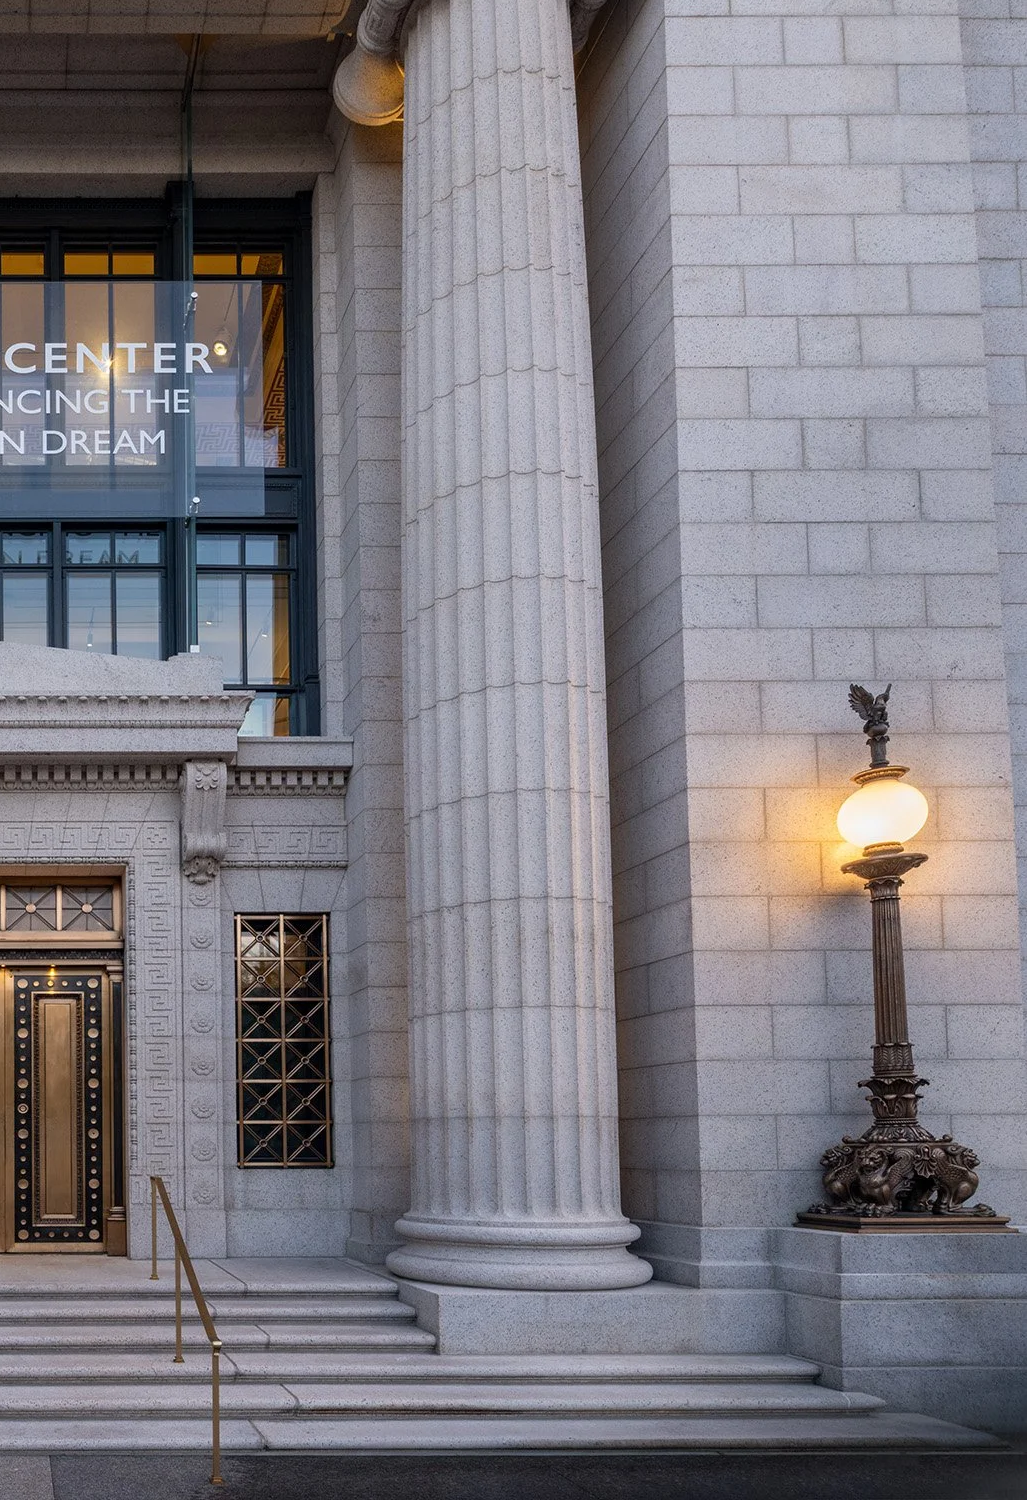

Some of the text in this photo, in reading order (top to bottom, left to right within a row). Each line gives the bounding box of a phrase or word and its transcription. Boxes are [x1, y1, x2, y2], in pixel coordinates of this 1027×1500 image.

[3, 342, 214, 374] CENTER
[121, 389, 190, 414] THE
[42, 430, 166, 455] DREAM
